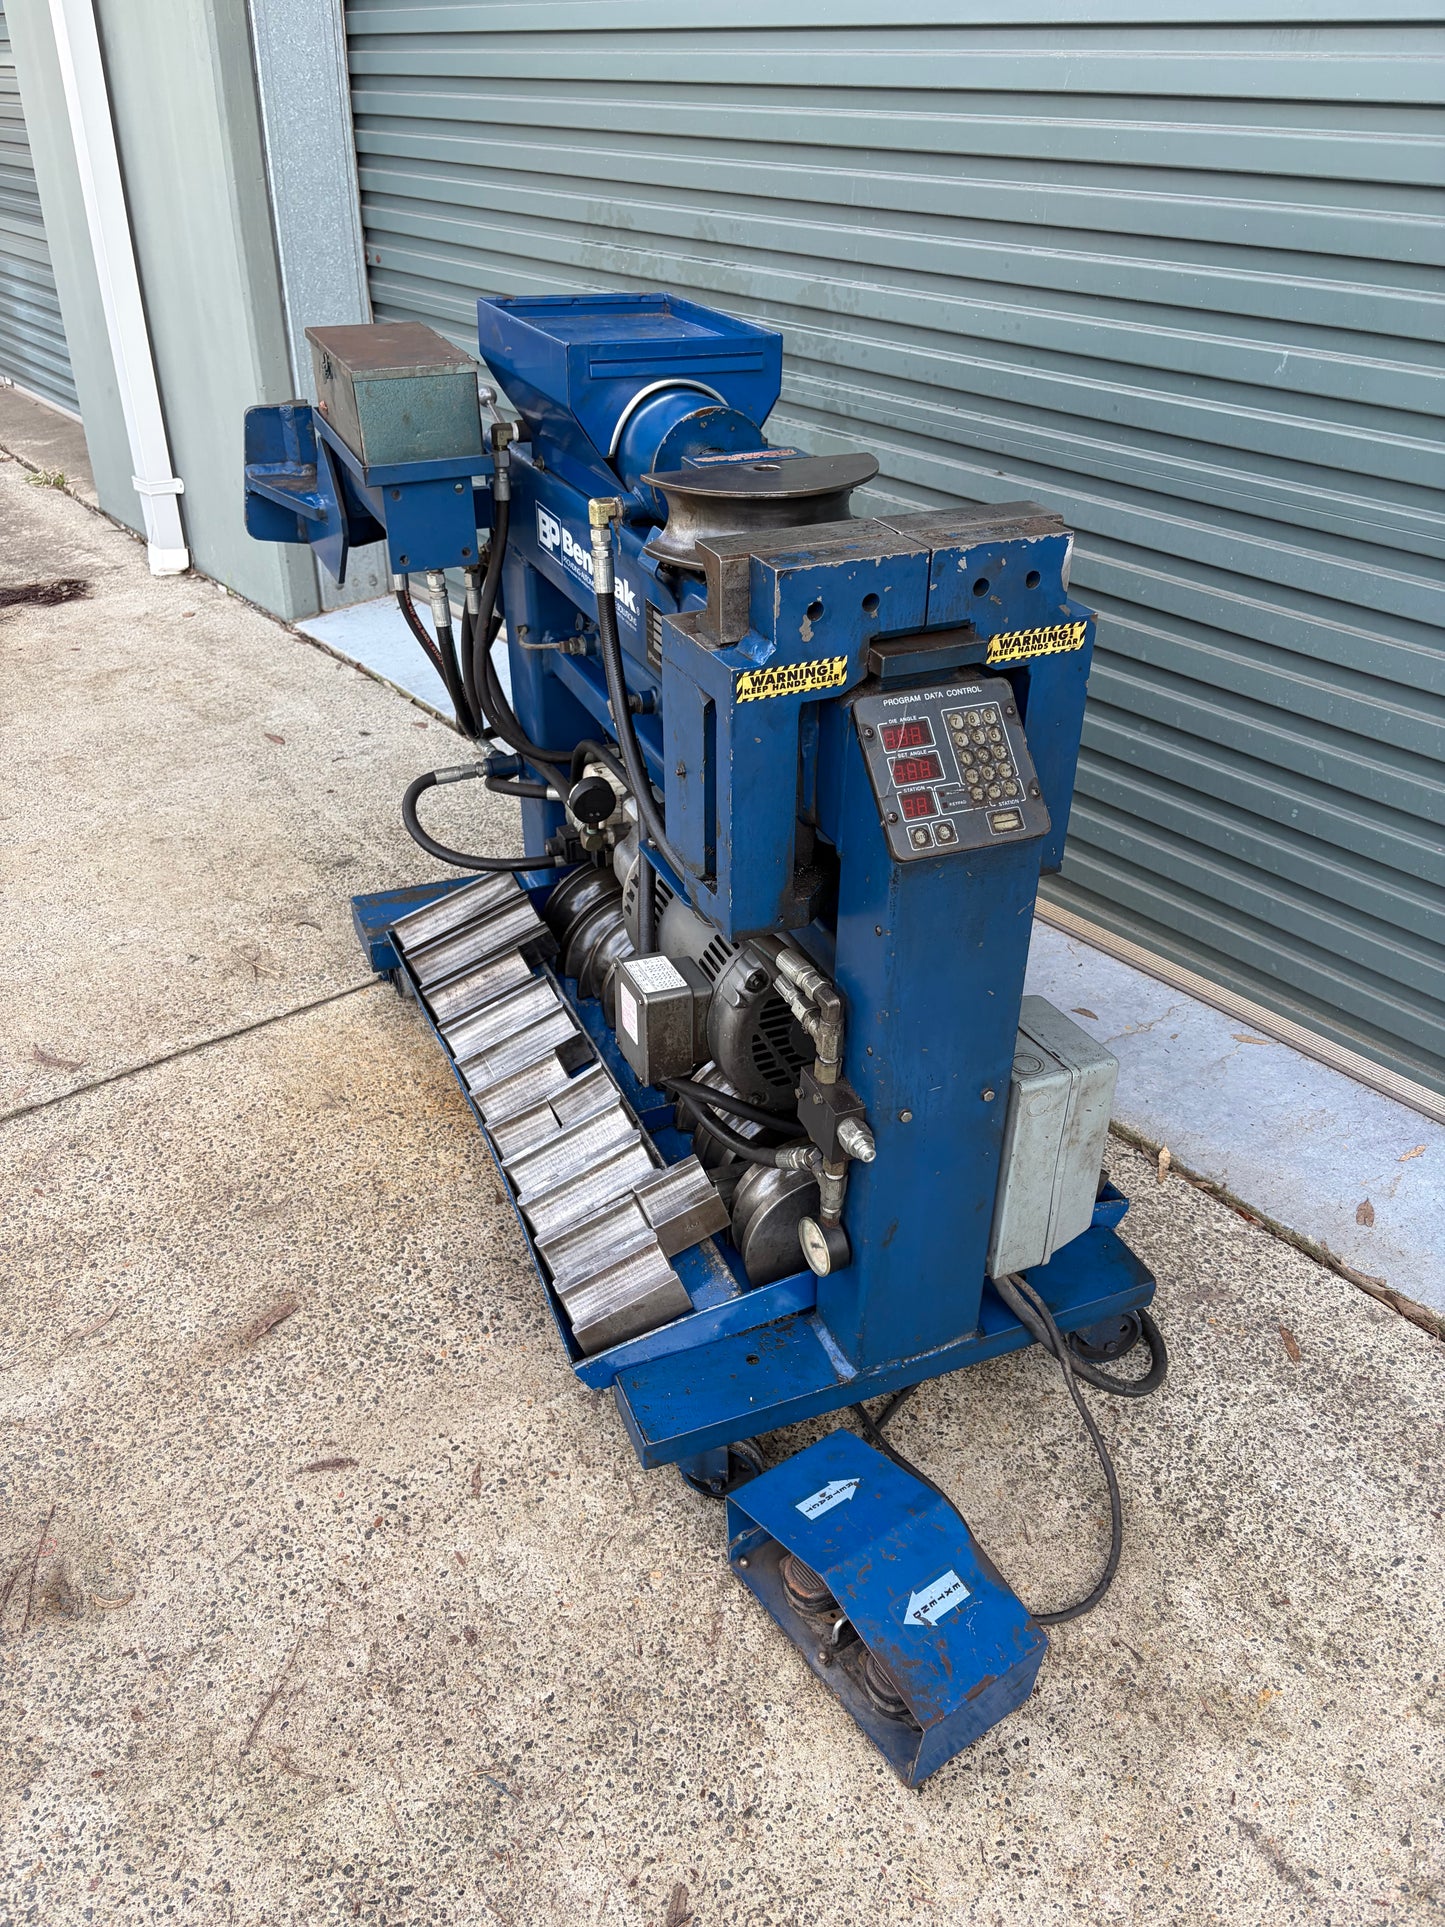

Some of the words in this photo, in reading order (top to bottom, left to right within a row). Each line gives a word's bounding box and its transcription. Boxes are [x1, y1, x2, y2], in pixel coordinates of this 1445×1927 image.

[538, 508, 560, 551] BP
[562, 527, 637, 614] Benak
[992, 648, 1015, 657] KEEP
[1018, 642, 1049, 653] HANDS
[1052, 638, 1078, 648] CLEAR
[999, 628, 1075, 650] WARNING!
[744, 685, 768, 695] KEEP
[772, 680, 807, 691] HANDS
[811, 673, 840, 685] CLEAR
[750, 663, 834, 687] WARNING!
[883, 694, 922, 707] PROGRAM
[924, 691, 944, 701] DATA
[946, 685, 983, 697] CONTROL
[899, 715, 917, 723] ANGLE
[903, 785, 926, 794] STATION
[998, 799, 1020, 807] STATION
[805, 1481, 854, 1513] RETRACT
[913, 1582, 960, 1619] EXTEND
